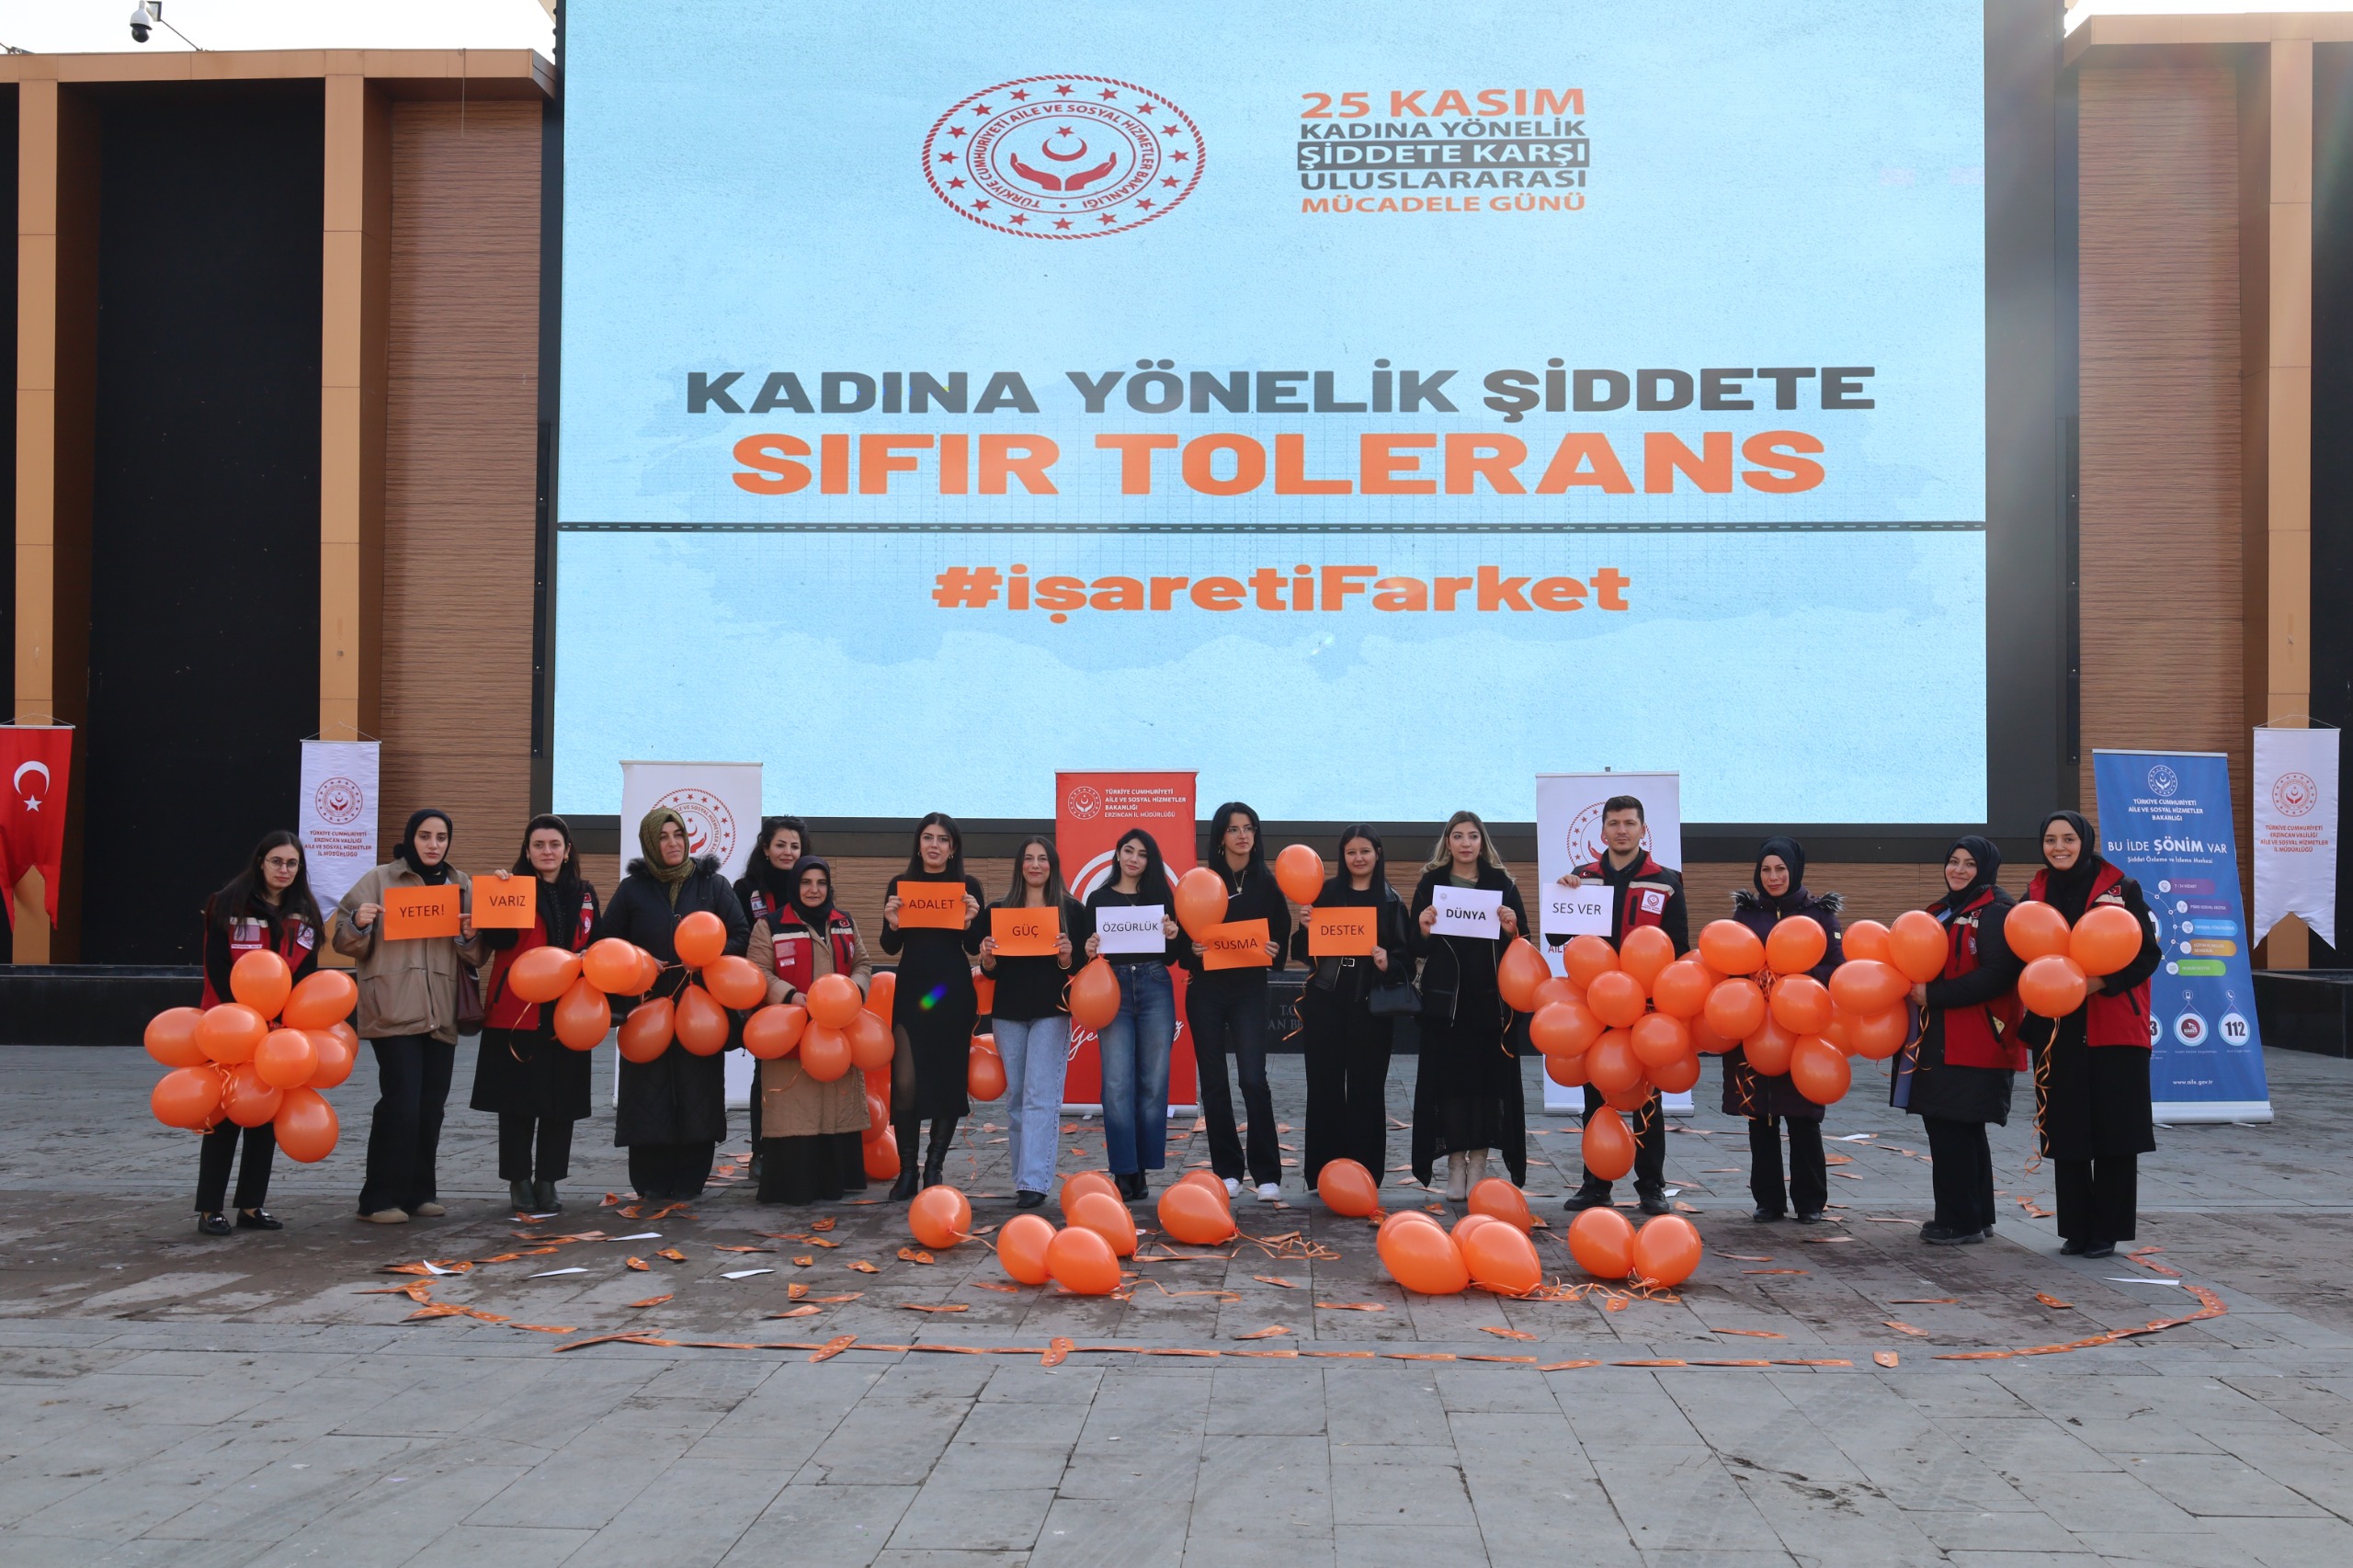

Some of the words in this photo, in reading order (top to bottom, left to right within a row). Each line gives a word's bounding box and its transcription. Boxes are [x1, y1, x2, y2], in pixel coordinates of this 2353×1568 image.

[1042, 104, 1063, 114] VE
[1301, 92, 1370, 119] 25
[1390, 88, 1585, 118] KASIM
[1010, 106, 1041, 123] AİLE
[1067, 104, 1122, 124] SOSYAL
[1301, 121, 1432, 140] KADINA
[1440, 118, 1586, 138] YÖNELİK
[973, 119, 1010, 181] CUMHURİYETİ
[1121, 118, 1154, 170] HİZMETLER
[1301, 142, 1461, 169] ŞİDDETE
[1473, 143, 1585, 166] KARŞI
[1302, 170, 1586, 190] ULUSLARARASI
[986, 181, 1040, 209] TÜRKİYE
[1082, 171, 1149, 209] BAKANLIĞI
[1302, 194, 1481, 213] MÜCADELE
[1489, 192, 1586, 211] GÜNÜ
[687, 371, 1040, 414] KADINA
[1064, 358, 1460, 414] YÖNELİK
[1483, 357, 1876, 424] ŞİDDETE
[732, 433, 1061, 495] SIFIR
[1095, 430, 1825, 496] TOLERANS
[930, 562, 1630, 624] #işaretiFarket
[2159, 798, 2197, 806] CUMHURİYETİ
[2108, 841, 2122, 852] BU
[2127, 838, 2150, 851] İLDE
[2154, 835, 2203, 855] ŞÖNİM
[2207, 843, 2227, 854] VAR
[2127, 856, 2145, 864] Şiddet
[2146, 855, 2167, 863] Önleme
[489, 894, 526, 906] VARIZ
[908, 899, 955, 910] ADALET
[1552, 902, 1574, 915] SES
[1578, 903, 1602, 915] VER
[399, 903, 445, 918] YETER!
[1446, 906, 1486, 921] DÜNYA
[1011, 924, 1039, 938] GÜÇ
[1102, 920, 1159, 933] ÖZGÜRLÜK
[1320, 925, 1365, 937] DESTEK
[1214, 937, 1258, 950] SUSMA
[2225, 1021, 2245, 1037] 112
